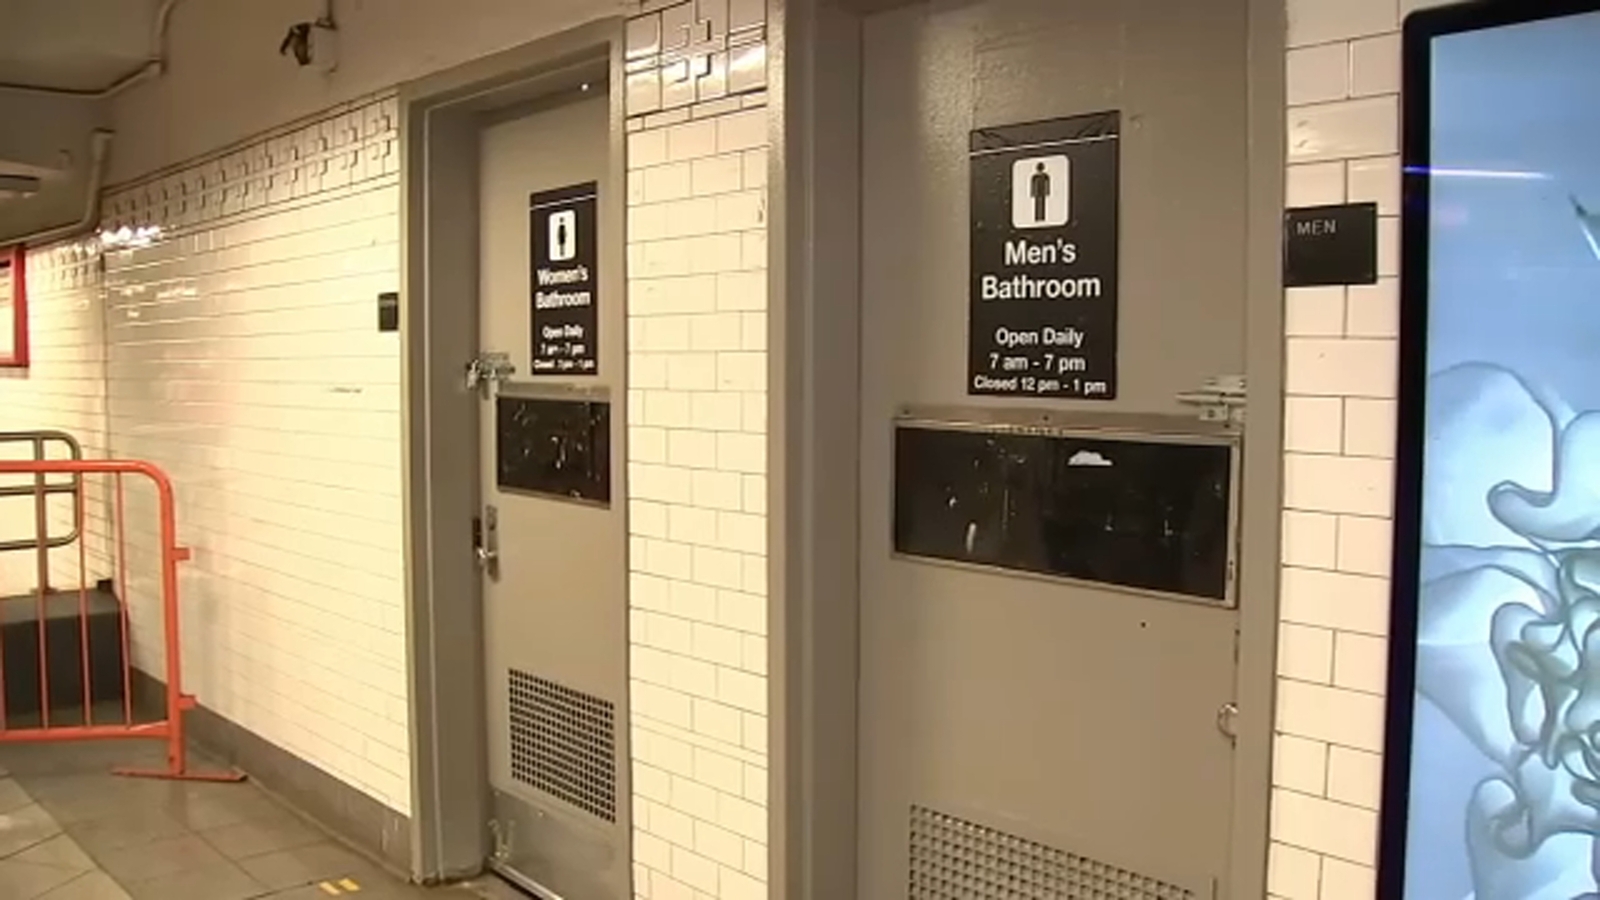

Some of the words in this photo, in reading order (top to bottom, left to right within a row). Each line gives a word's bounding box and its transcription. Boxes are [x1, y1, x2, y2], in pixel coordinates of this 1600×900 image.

[1297, 220, 1336, 235] MEN
[1004, 238, 1076, 265] Men's
[537, 264, 588, 286] Women's
[982, 274, 1101, 300] Bathroom
[536, 290, 591, 309] Bathroom
[542, 326, 563, 339] Open
[564, 324, 584, 338] Daily
[995, 327, 1039, 348] Open
[1042, 327, 1084, 348] Daily
[990, 353, 999, 370] 7
[1003, 357, 1028, 370] am
[1044, 354, 1054, 370] 7
[1059, 357, 1086, 374] pm
[974, 375, 1017, 391] Closed
[1021, 377, 1036, 391] 12
[1037, 379, 1060, 393] pm
[1073, 379, 1080, 392] 1
[1084, 381, 1107, 396] pm
